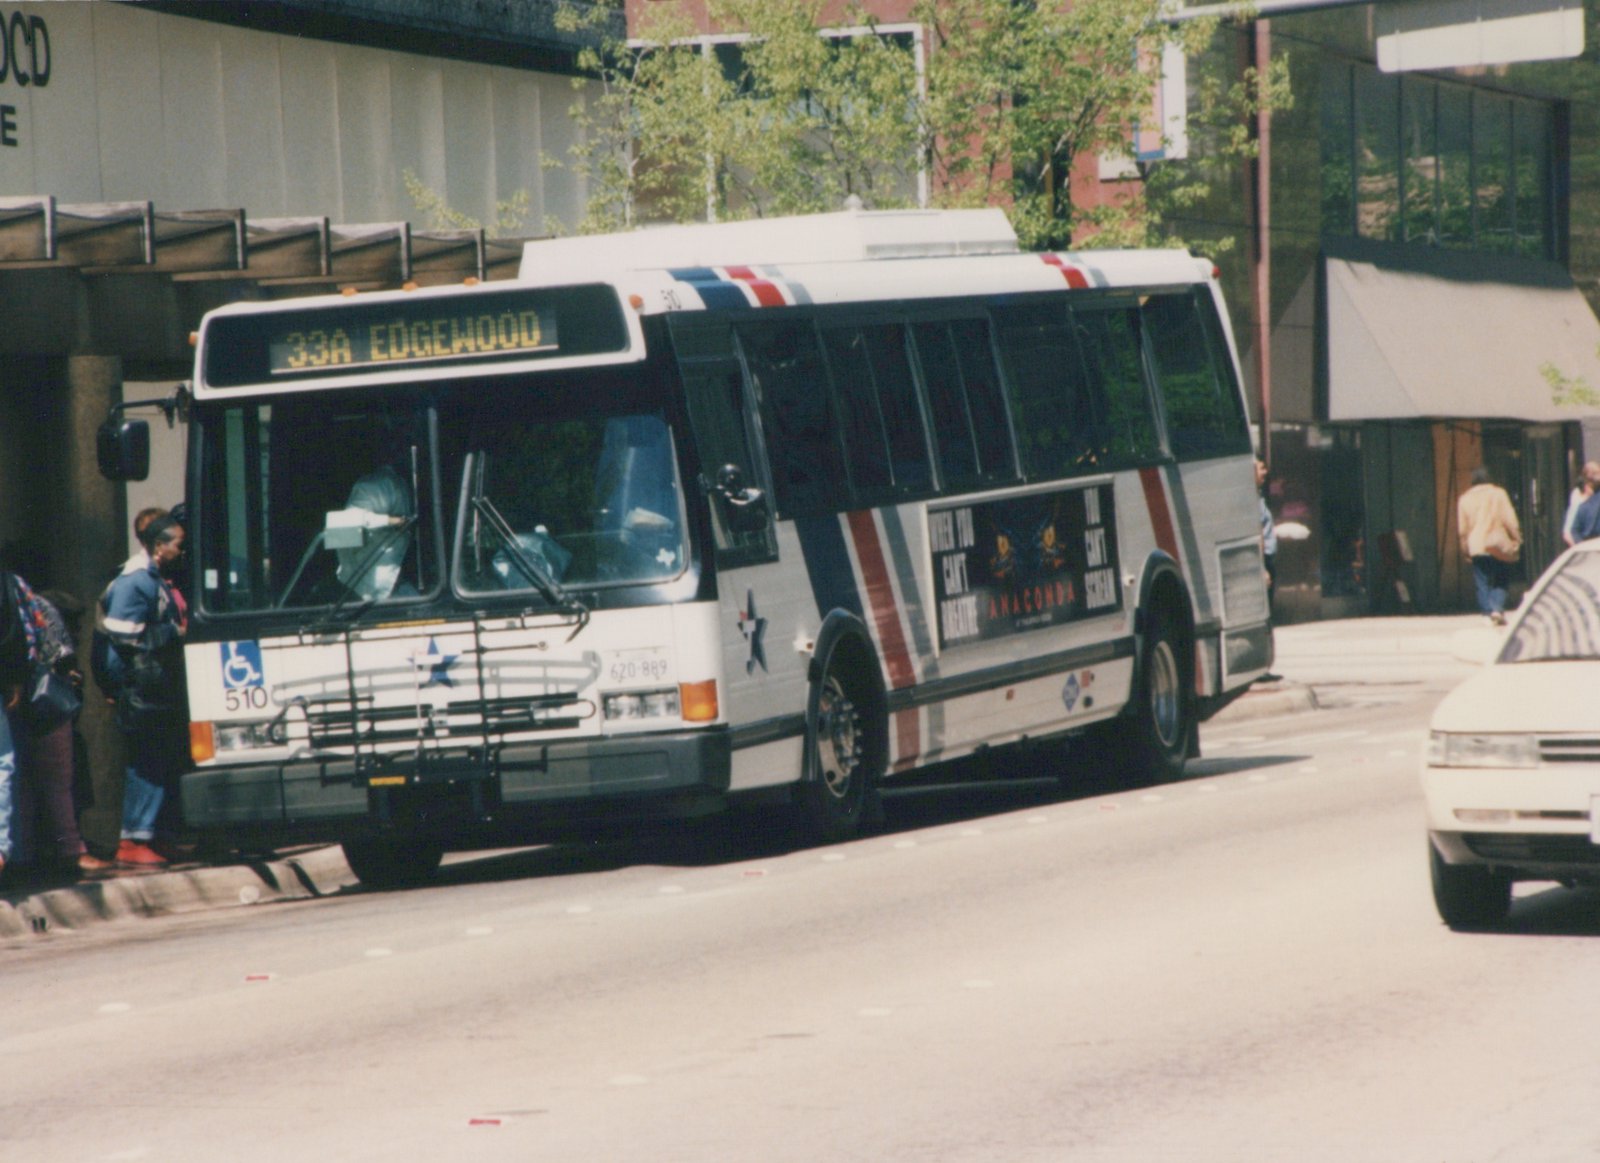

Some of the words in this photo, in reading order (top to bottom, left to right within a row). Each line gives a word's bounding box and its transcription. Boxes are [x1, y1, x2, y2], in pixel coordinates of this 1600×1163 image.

[287, 329, 351, 368] 33A
[370, 311, 541, 360] EDGEWOOD
[989, 581, 1074, 618] ANACONDA
[226, 688, 267, 712] 510
